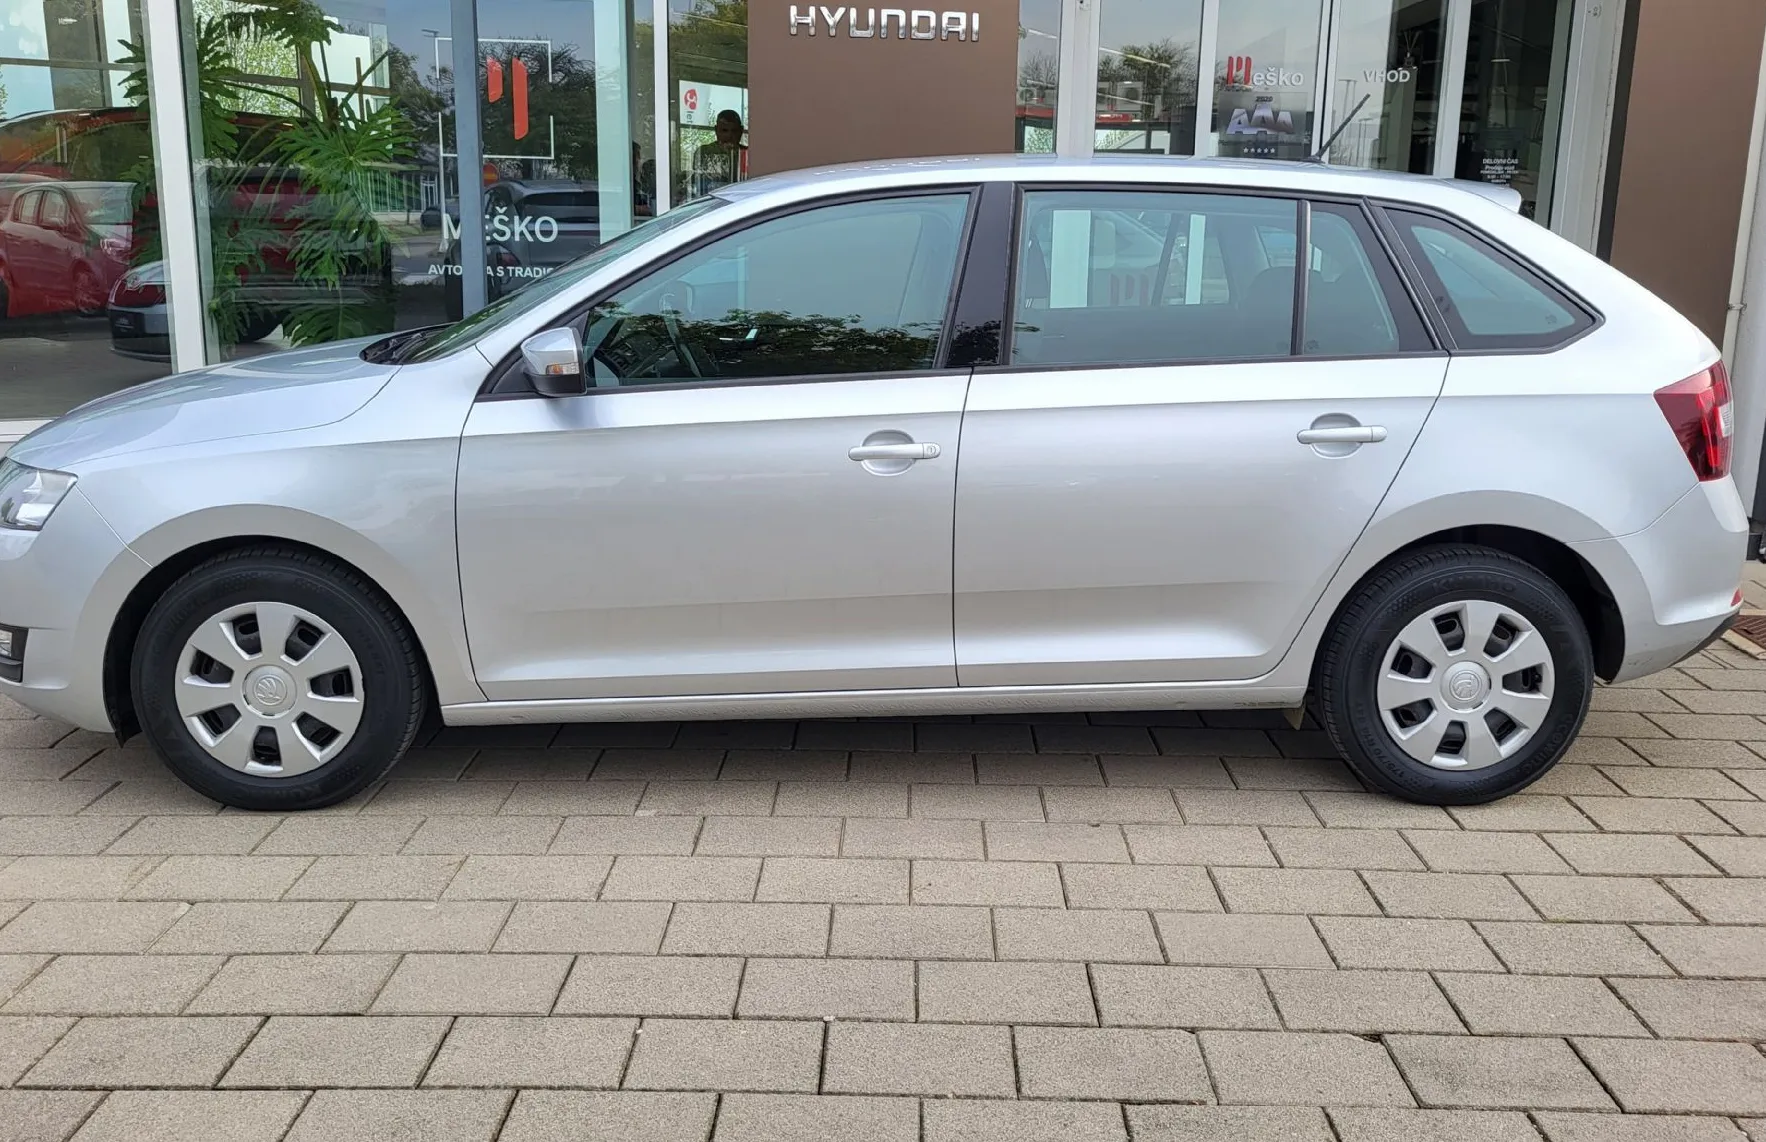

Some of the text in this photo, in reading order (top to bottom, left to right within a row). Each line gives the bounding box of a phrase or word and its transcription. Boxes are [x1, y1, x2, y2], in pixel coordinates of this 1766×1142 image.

[789, 5, 980, 42] HYUNDAI
[1363, 69, 1410, 83] VHOD
[496, 266, 505, 277] S
